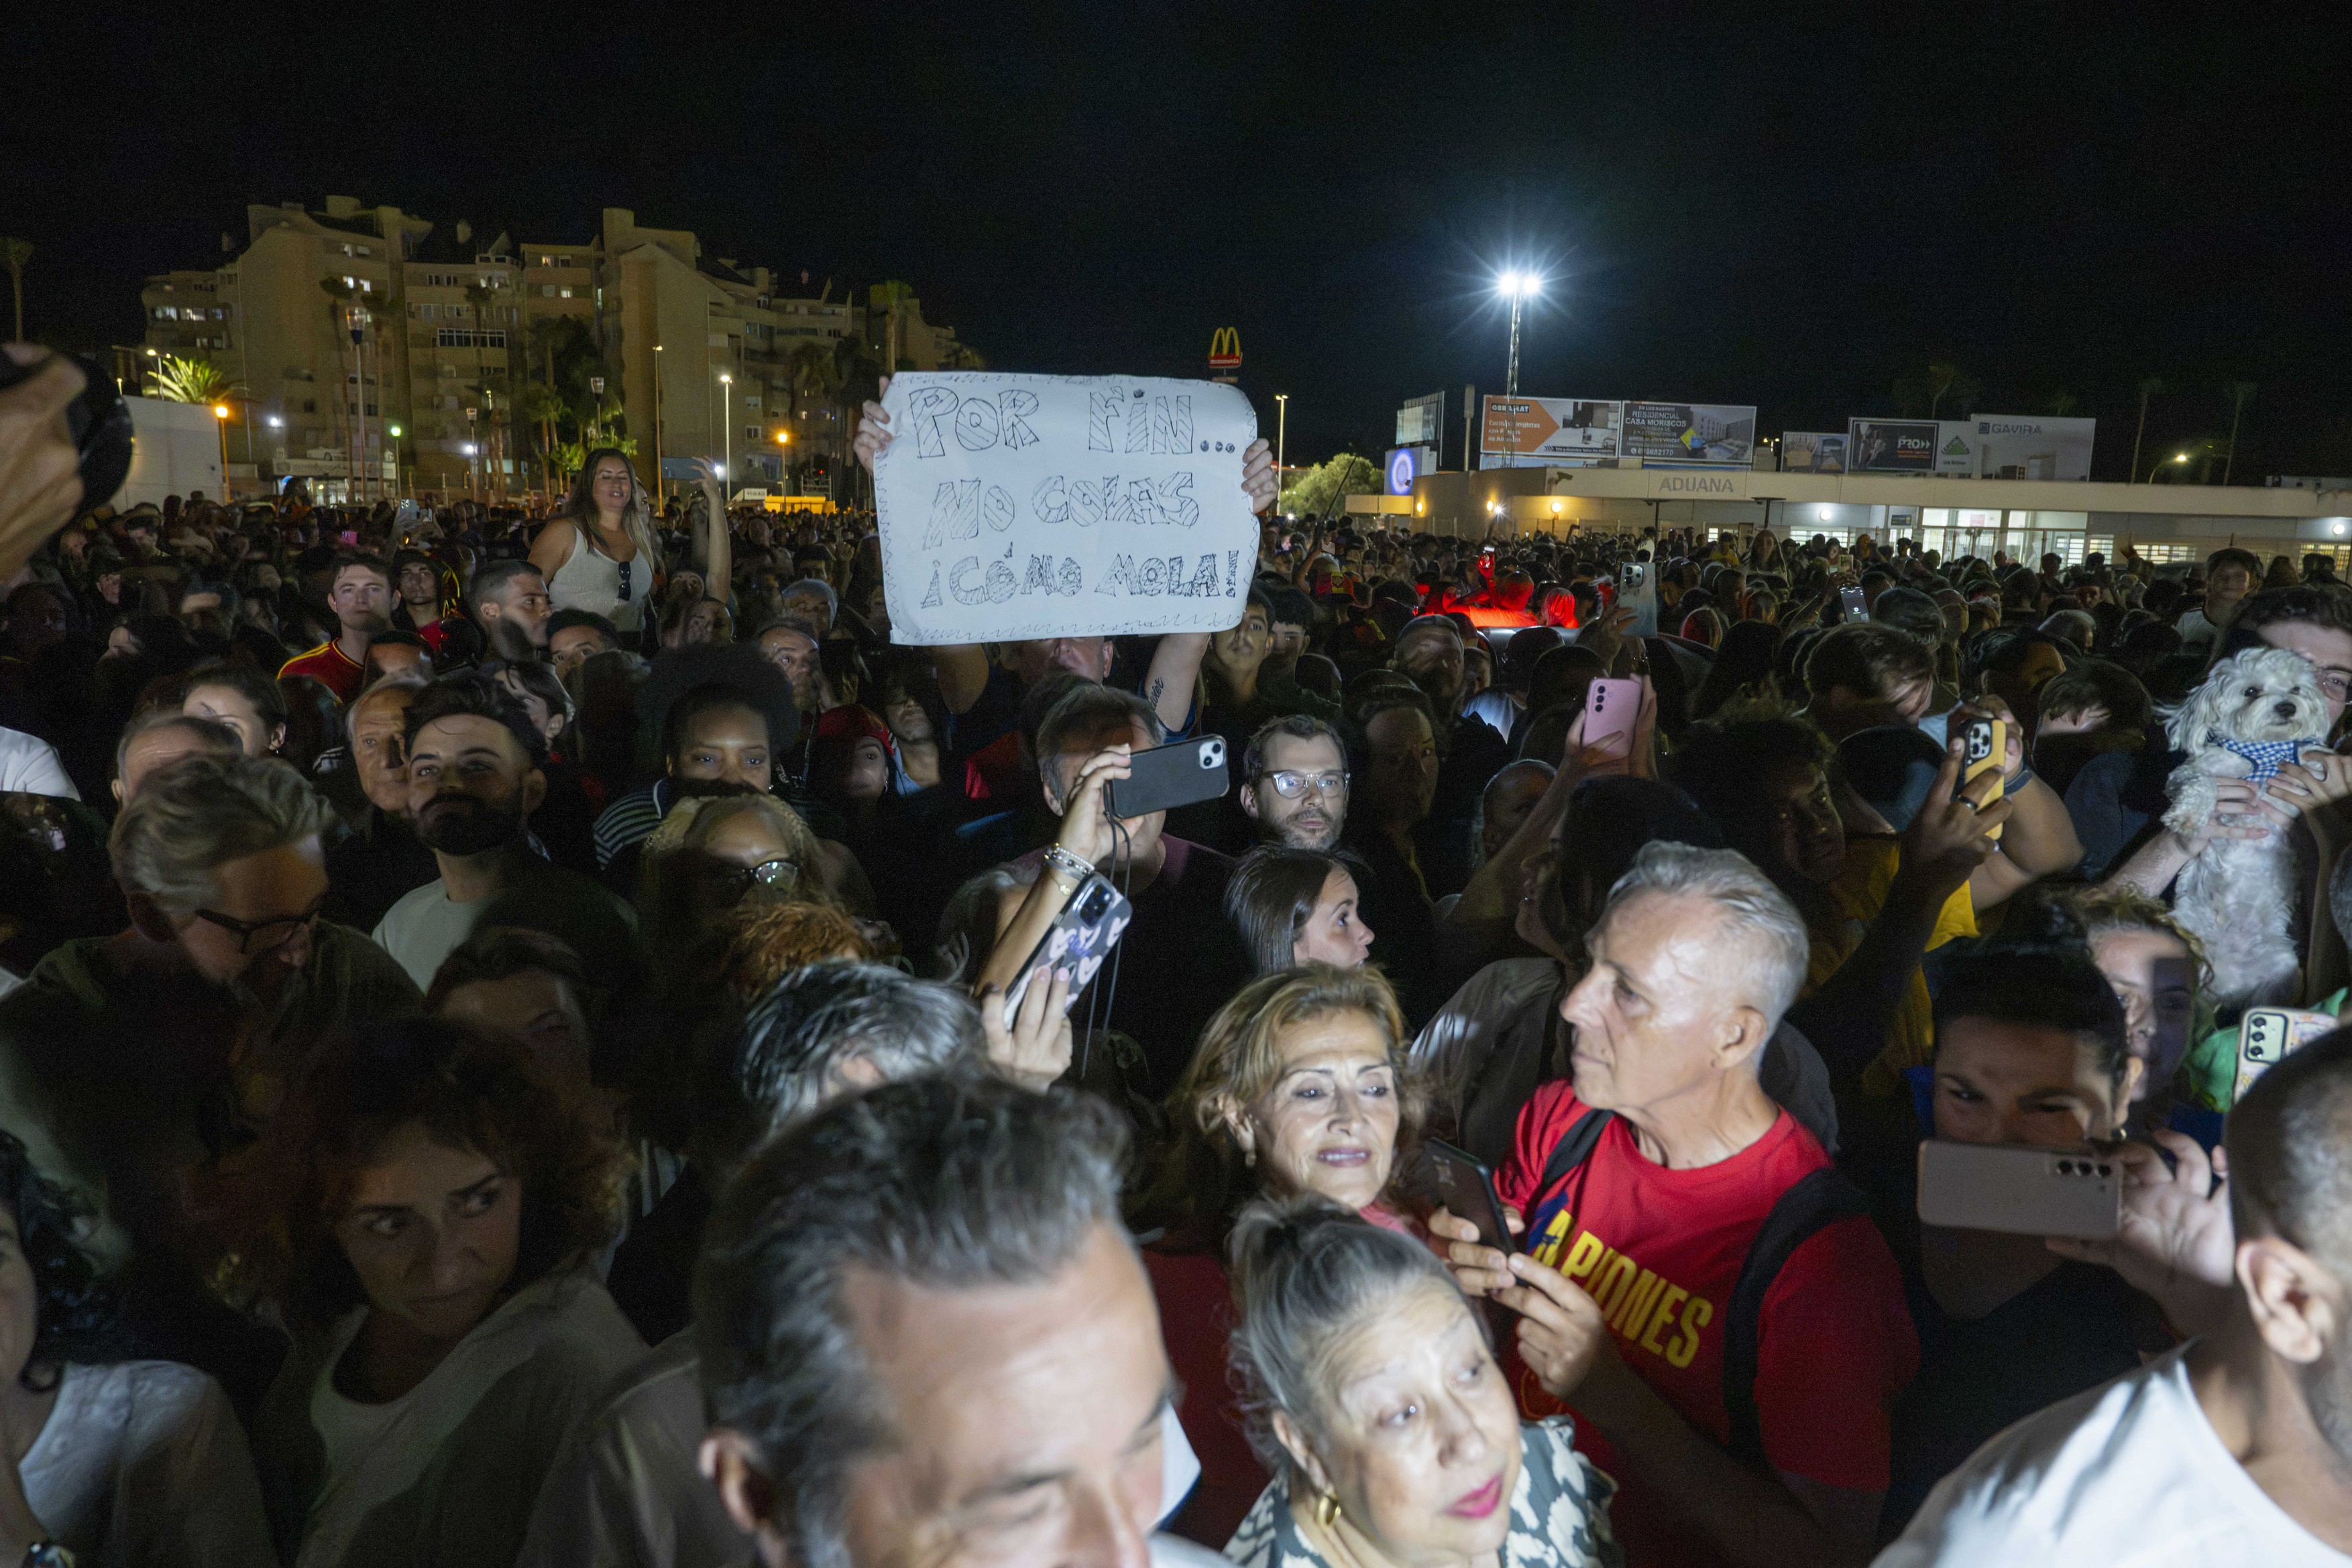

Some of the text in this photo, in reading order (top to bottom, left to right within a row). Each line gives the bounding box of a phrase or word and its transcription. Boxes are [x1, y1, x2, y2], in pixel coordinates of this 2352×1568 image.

[909, 386, 1040, 458] POR
[1632, 410, 1680, 420] RESIDENCIAL
[1647, 419, 1687, 427] MORISCOS
[1992, 424, 2041, 436] GAVIRA
[1659, 477, 1734, 492] ADUANA
[922, 471, 1200, 551] NO COLAS
[1095, 550, 1239, 598] MOLA!
